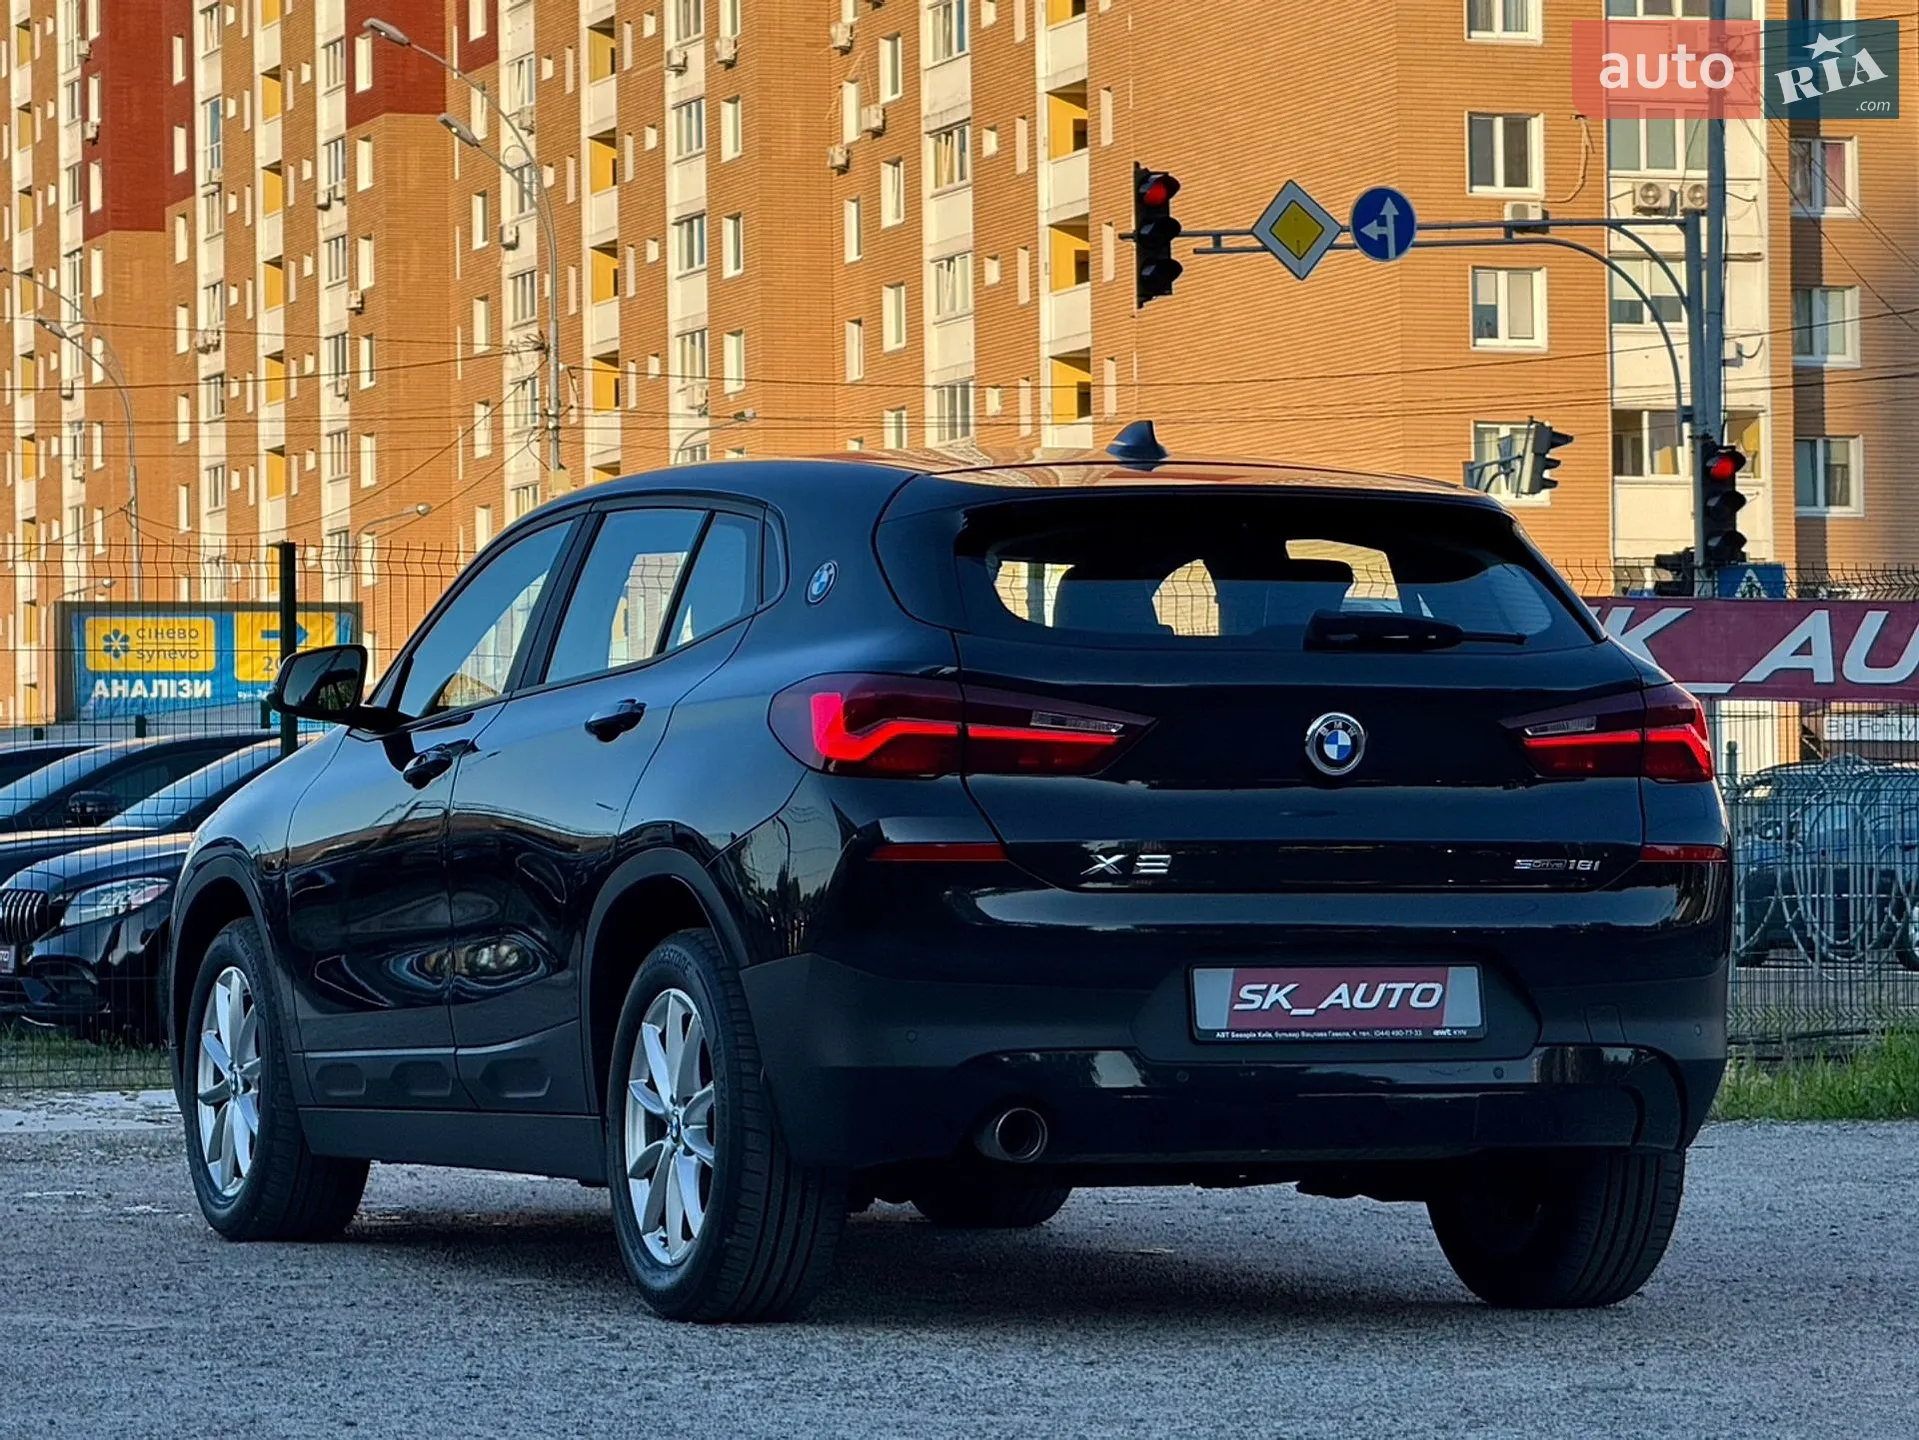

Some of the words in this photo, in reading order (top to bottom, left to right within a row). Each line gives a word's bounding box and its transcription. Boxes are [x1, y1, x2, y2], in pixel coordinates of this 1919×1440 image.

[136, 648, 199, 664] synevo
[1586, 606, 1919, 693] K_AU
[91, 679, 212, 699] АНАЛІЗИ
[1318, 720, 1358, 737] BMW
[1233, 983, 1443, 1016] SK_AUTO
